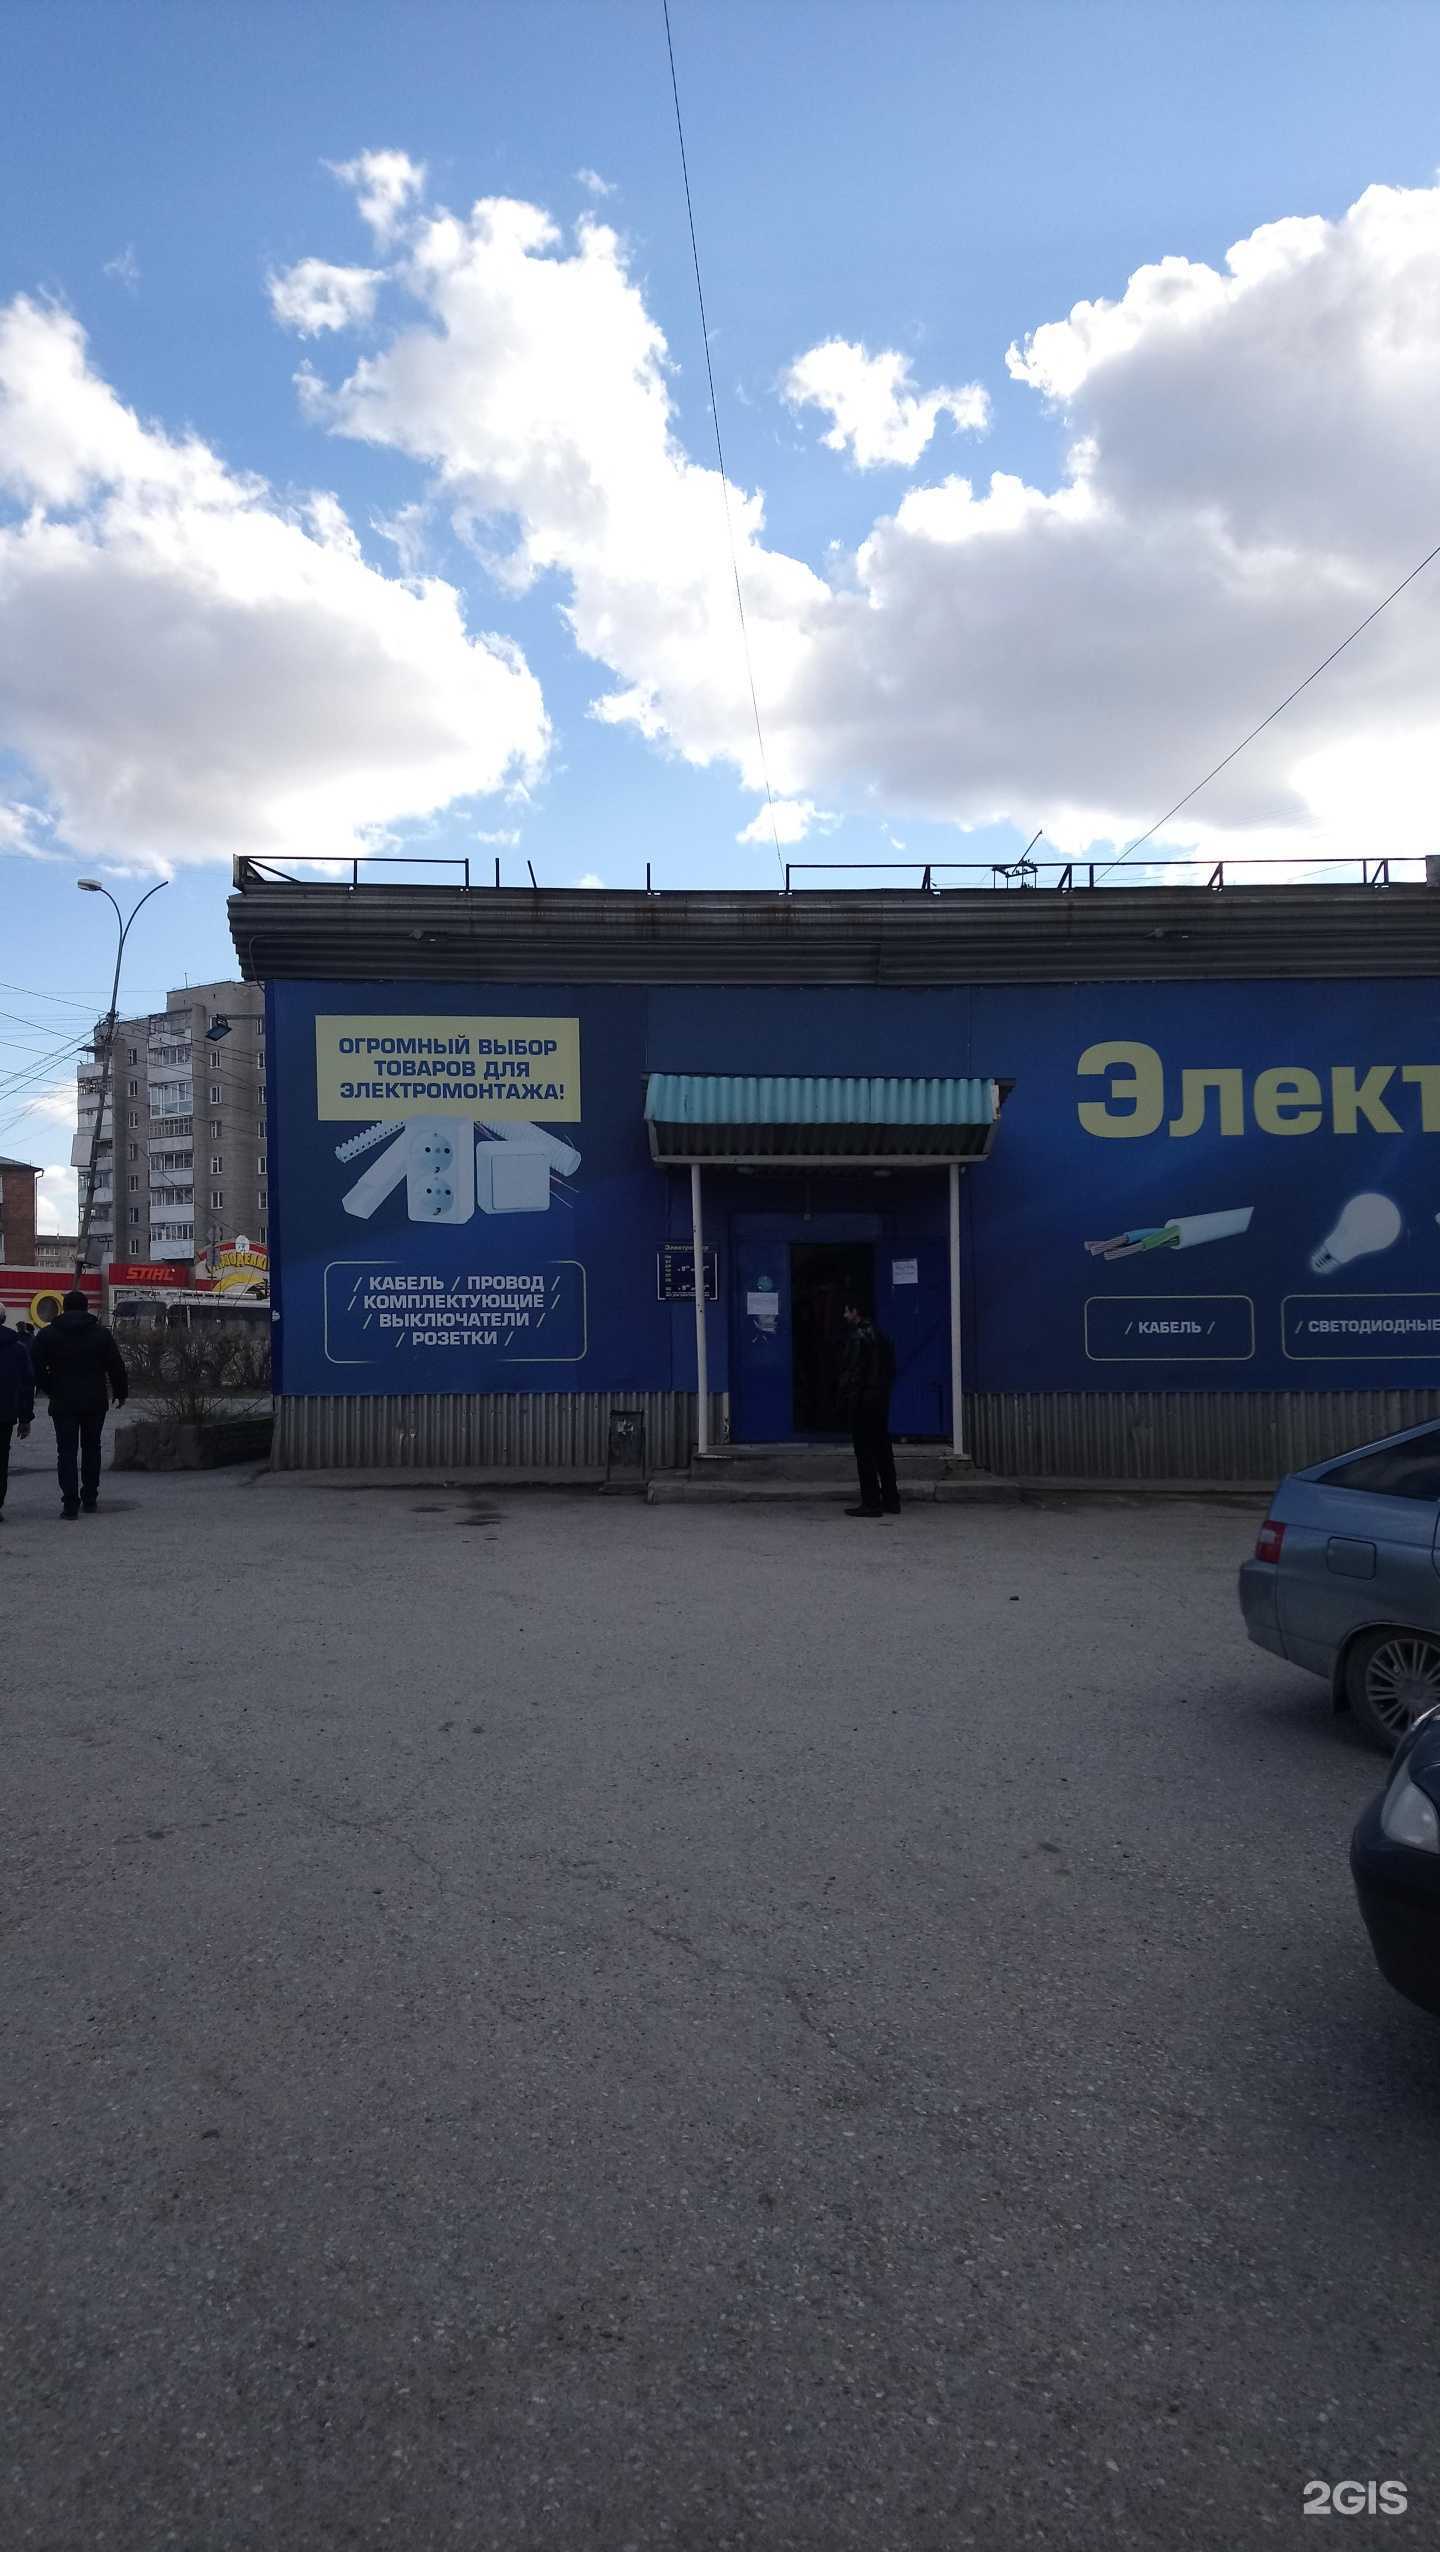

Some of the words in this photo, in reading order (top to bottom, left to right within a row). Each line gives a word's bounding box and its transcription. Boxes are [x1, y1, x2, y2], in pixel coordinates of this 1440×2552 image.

[339, 1035, 470, 1055] ОГРОМНЫЙ
[479, 1038, 557, 1055] ВЫБОР
[374, 1061, 475, 1076] ТОВАРОВ
[484, 1061, 529, 1080] ДЛЯ
[340, 1082, 564, 1099] ЭЛЕКТРОМОНТАЖА!
[126, 1267, 173, 1280] STIHL
[369, 1277, 444, 1290] КАБЕЛЬ
[468, 1276, 544, 1292] ПРОВОД
[364, 1295, 544, 1309] КОМПЛЕКТУЮЩИЕ
[379, 1313, 529, 1327] ВЫКЛЮЧАТЕЛИ
[1308, 1319, 1440, 1334] СВЕТОДИОДНЫЕ
[1138, 1322, 1201, 1333] КАБЕЛЬ
[413, 1332, 497, 1345] РОЗЕТКИ
